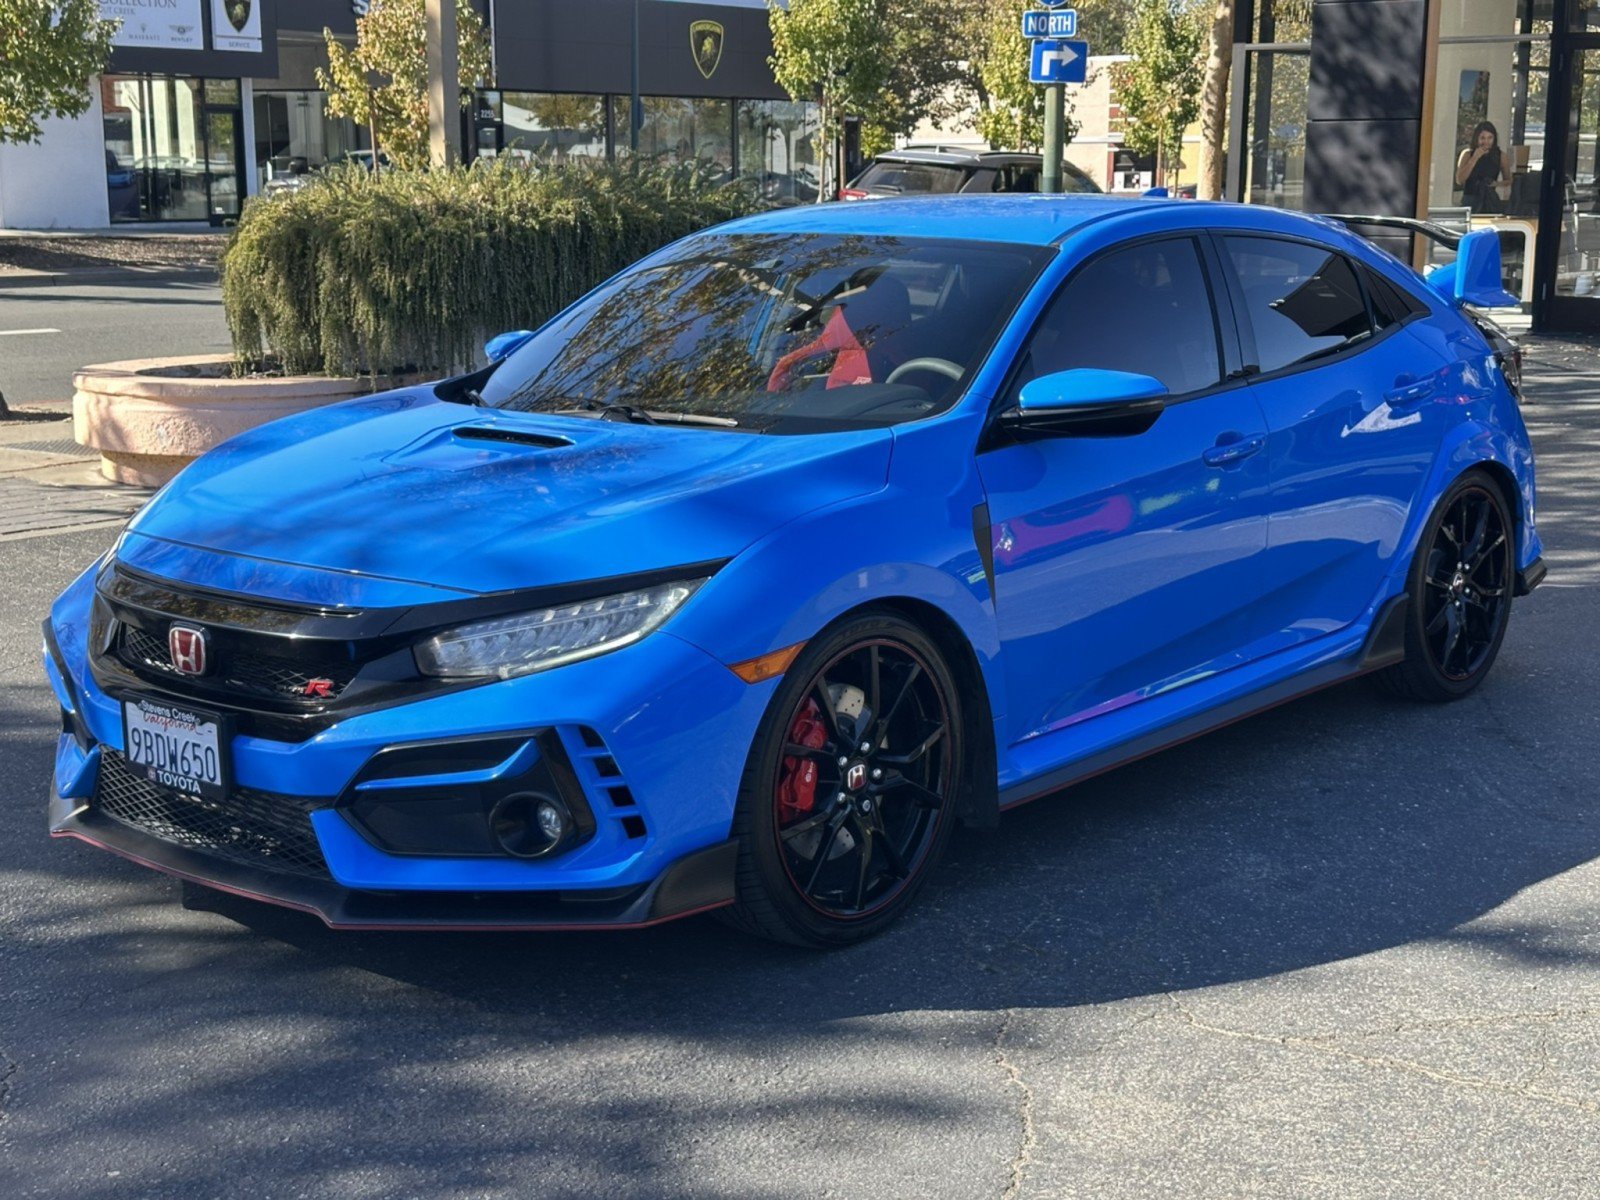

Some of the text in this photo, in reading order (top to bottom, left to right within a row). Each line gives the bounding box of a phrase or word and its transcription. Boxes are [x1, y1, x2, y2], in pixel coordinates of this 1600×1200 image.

[1028, 15, 1072, 32] NORTH
[228, 41, 250, 49] SERVICE
[141, 699, 196, 723] Stevens Creek
[131, 727, 217, 783] 9BDW650
[157, 770, 202, 794] TOYOTA
